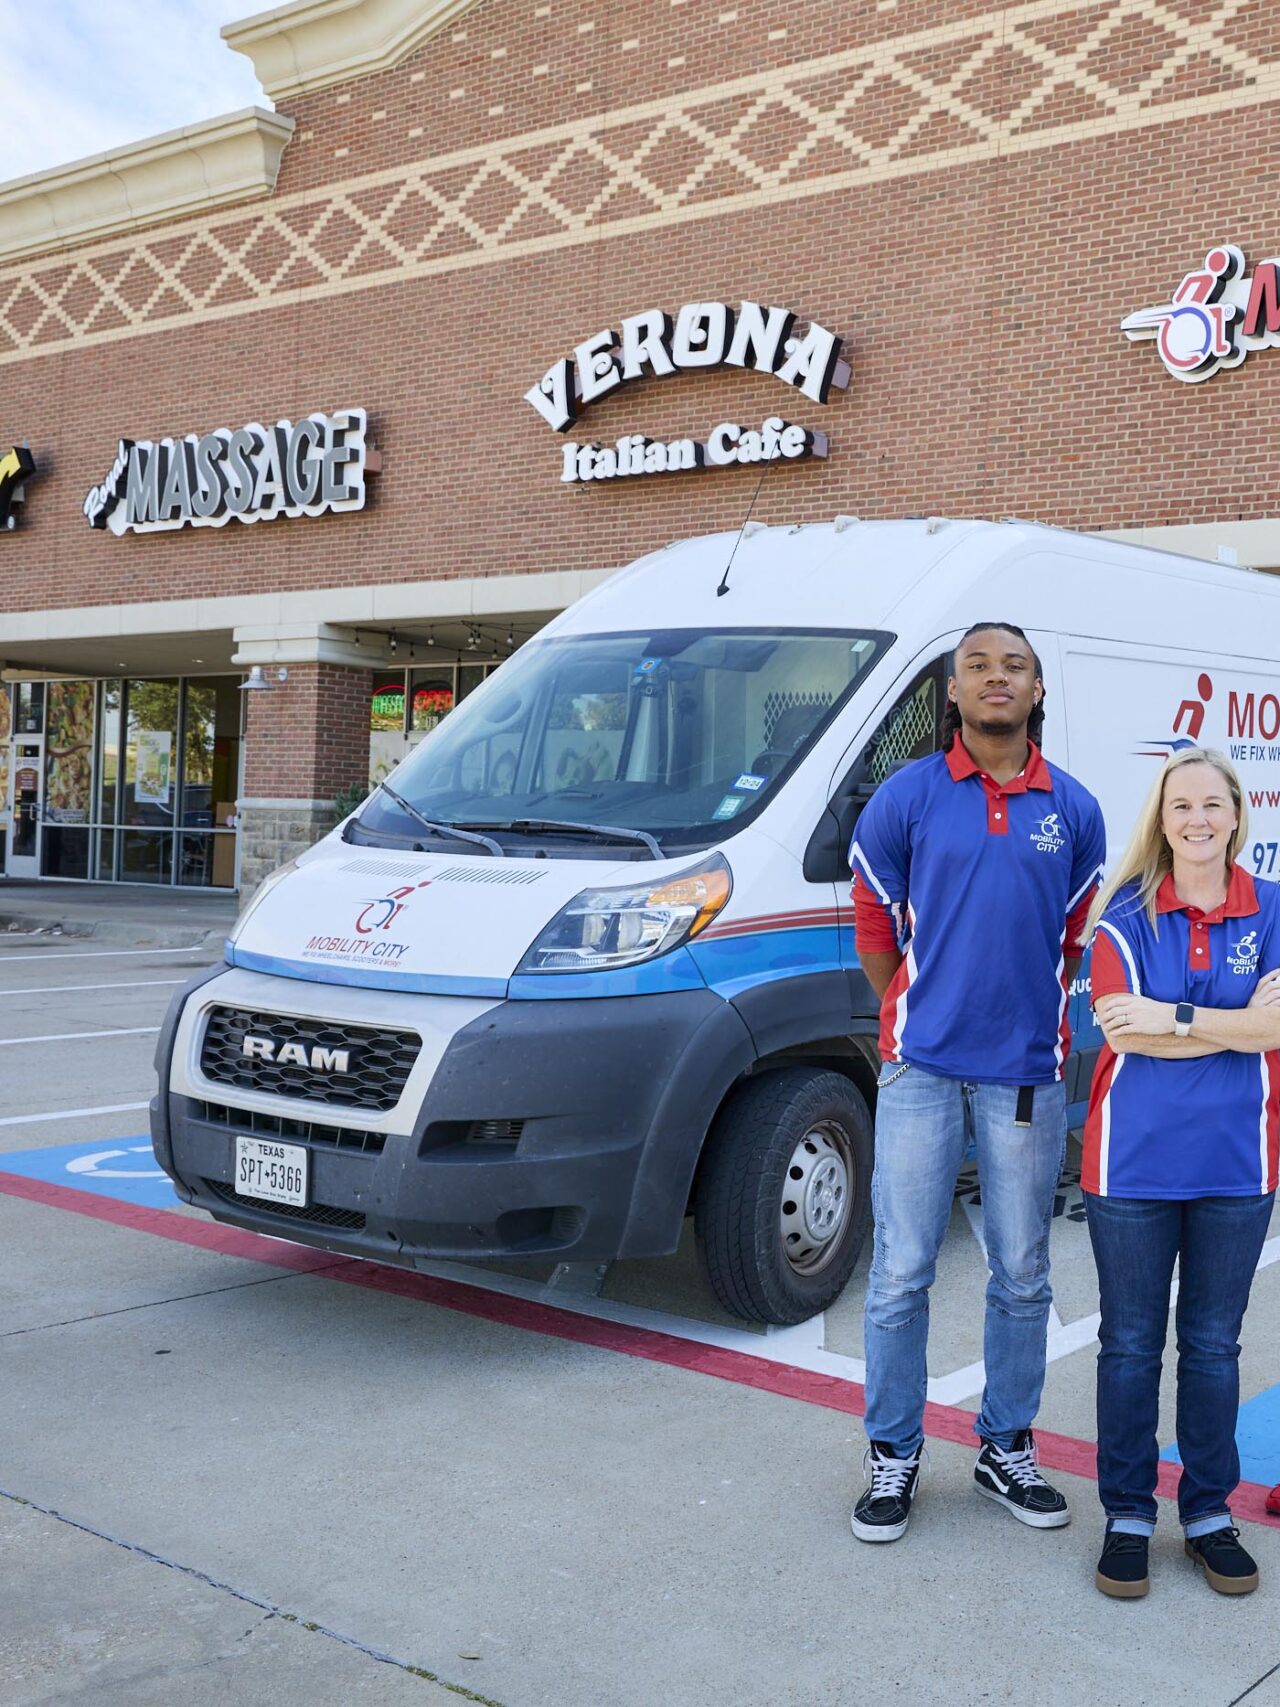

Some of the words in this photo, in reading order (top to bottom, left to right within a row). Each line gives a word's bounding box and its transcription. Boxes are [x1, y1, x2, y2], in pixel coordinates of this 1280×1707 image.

[523, 300, 842, 433] VERONA
[560, 434, 703, 484] Italian
[708, 416, 812, 467] Cafe
[126, 414, 358, 524] MASSAGE
[1230, 744, 1247, 761] WE
[1250, 746, 1266, 761] FIX
[1029, 834, 1066, 846] MOBILITY
[1036, 842, 1059, 854] CITY
[305, 936, 375, 954] MOBILITY
[372, 942, 410, 959] CITY
[1232, 964, 1257, 975] CITY
[242, 1034, 350, 1073] RAM
[257, 1143, 286, 1159] TEXAS
